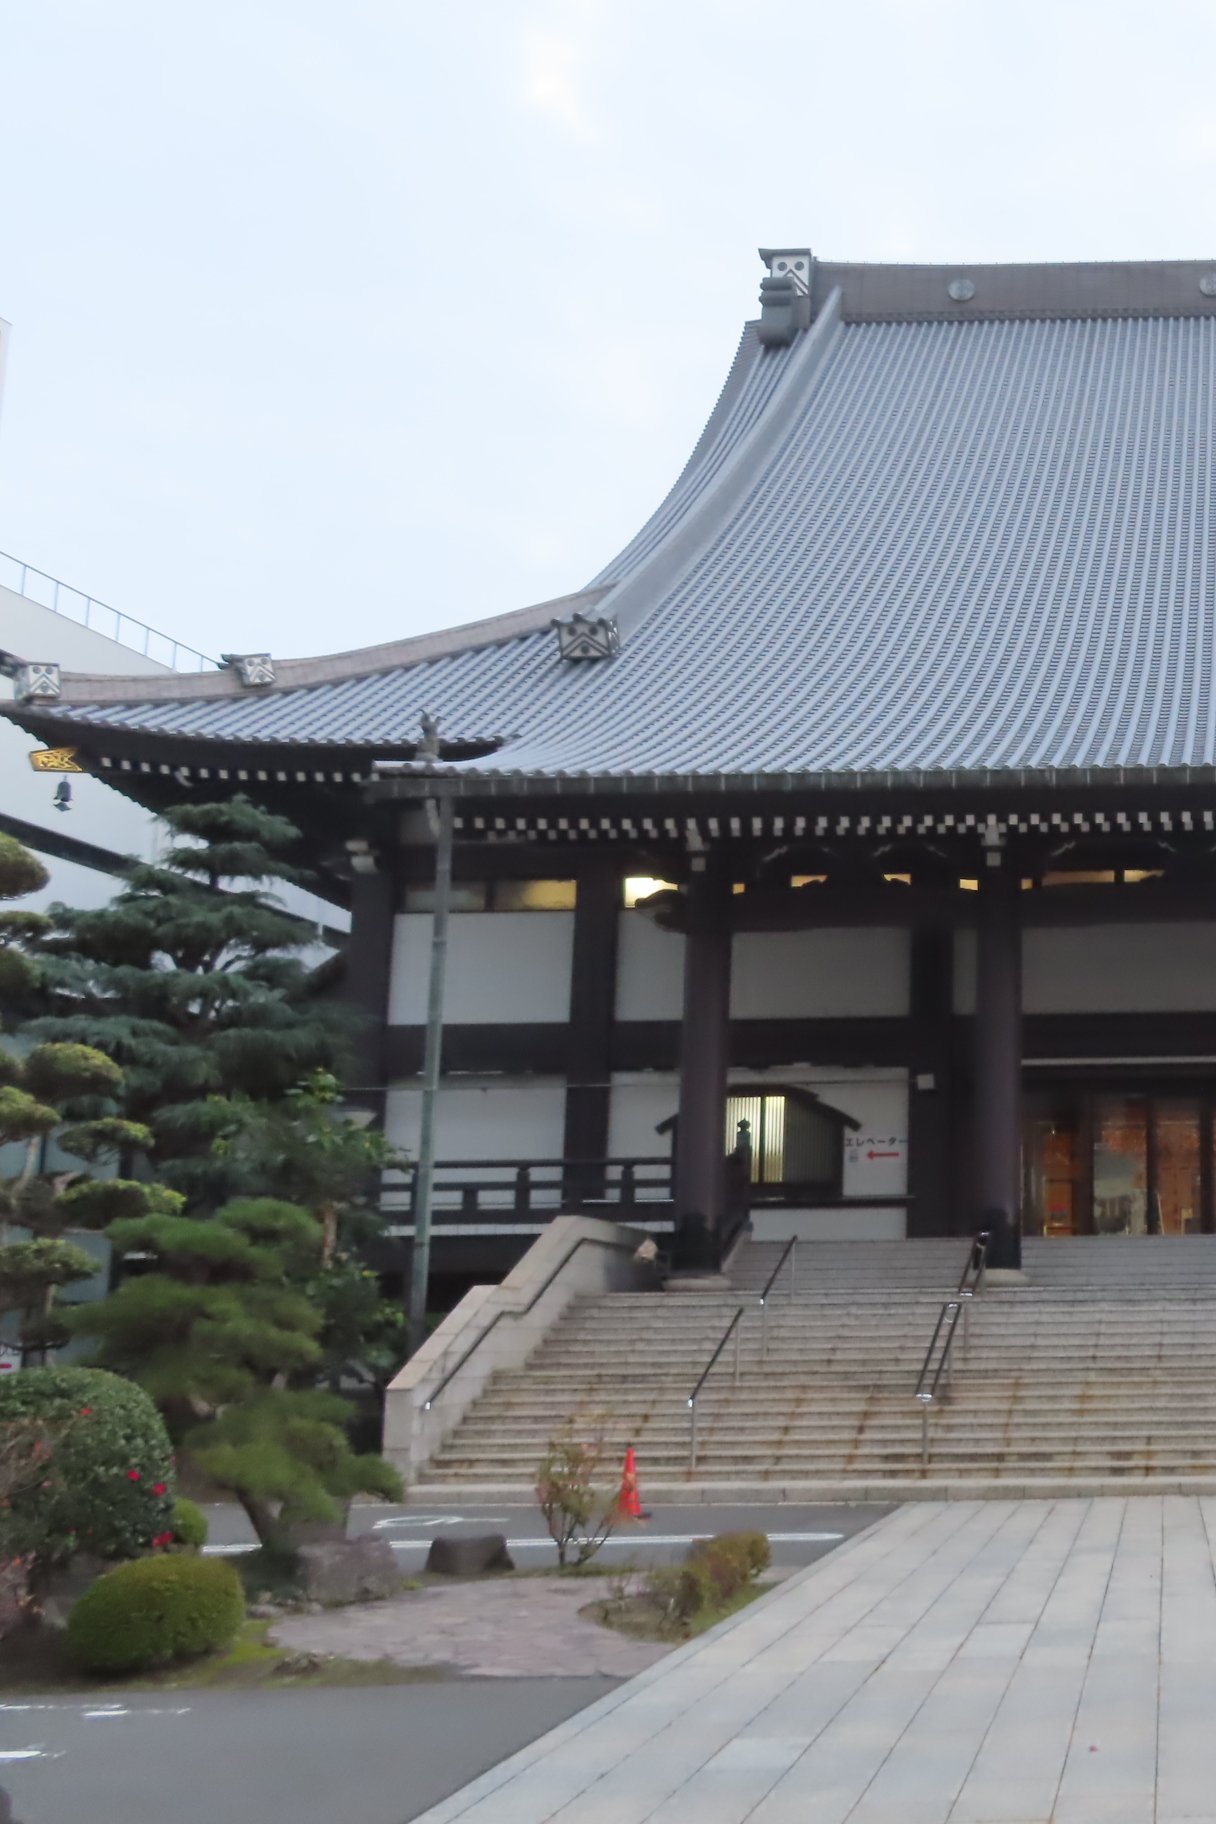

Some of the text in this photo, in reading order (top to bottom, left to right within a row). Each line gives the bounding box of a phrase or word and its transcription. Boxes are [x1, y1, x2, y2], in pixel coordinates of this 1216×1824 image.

[846, 1137, 909, 1148] エレベーター
